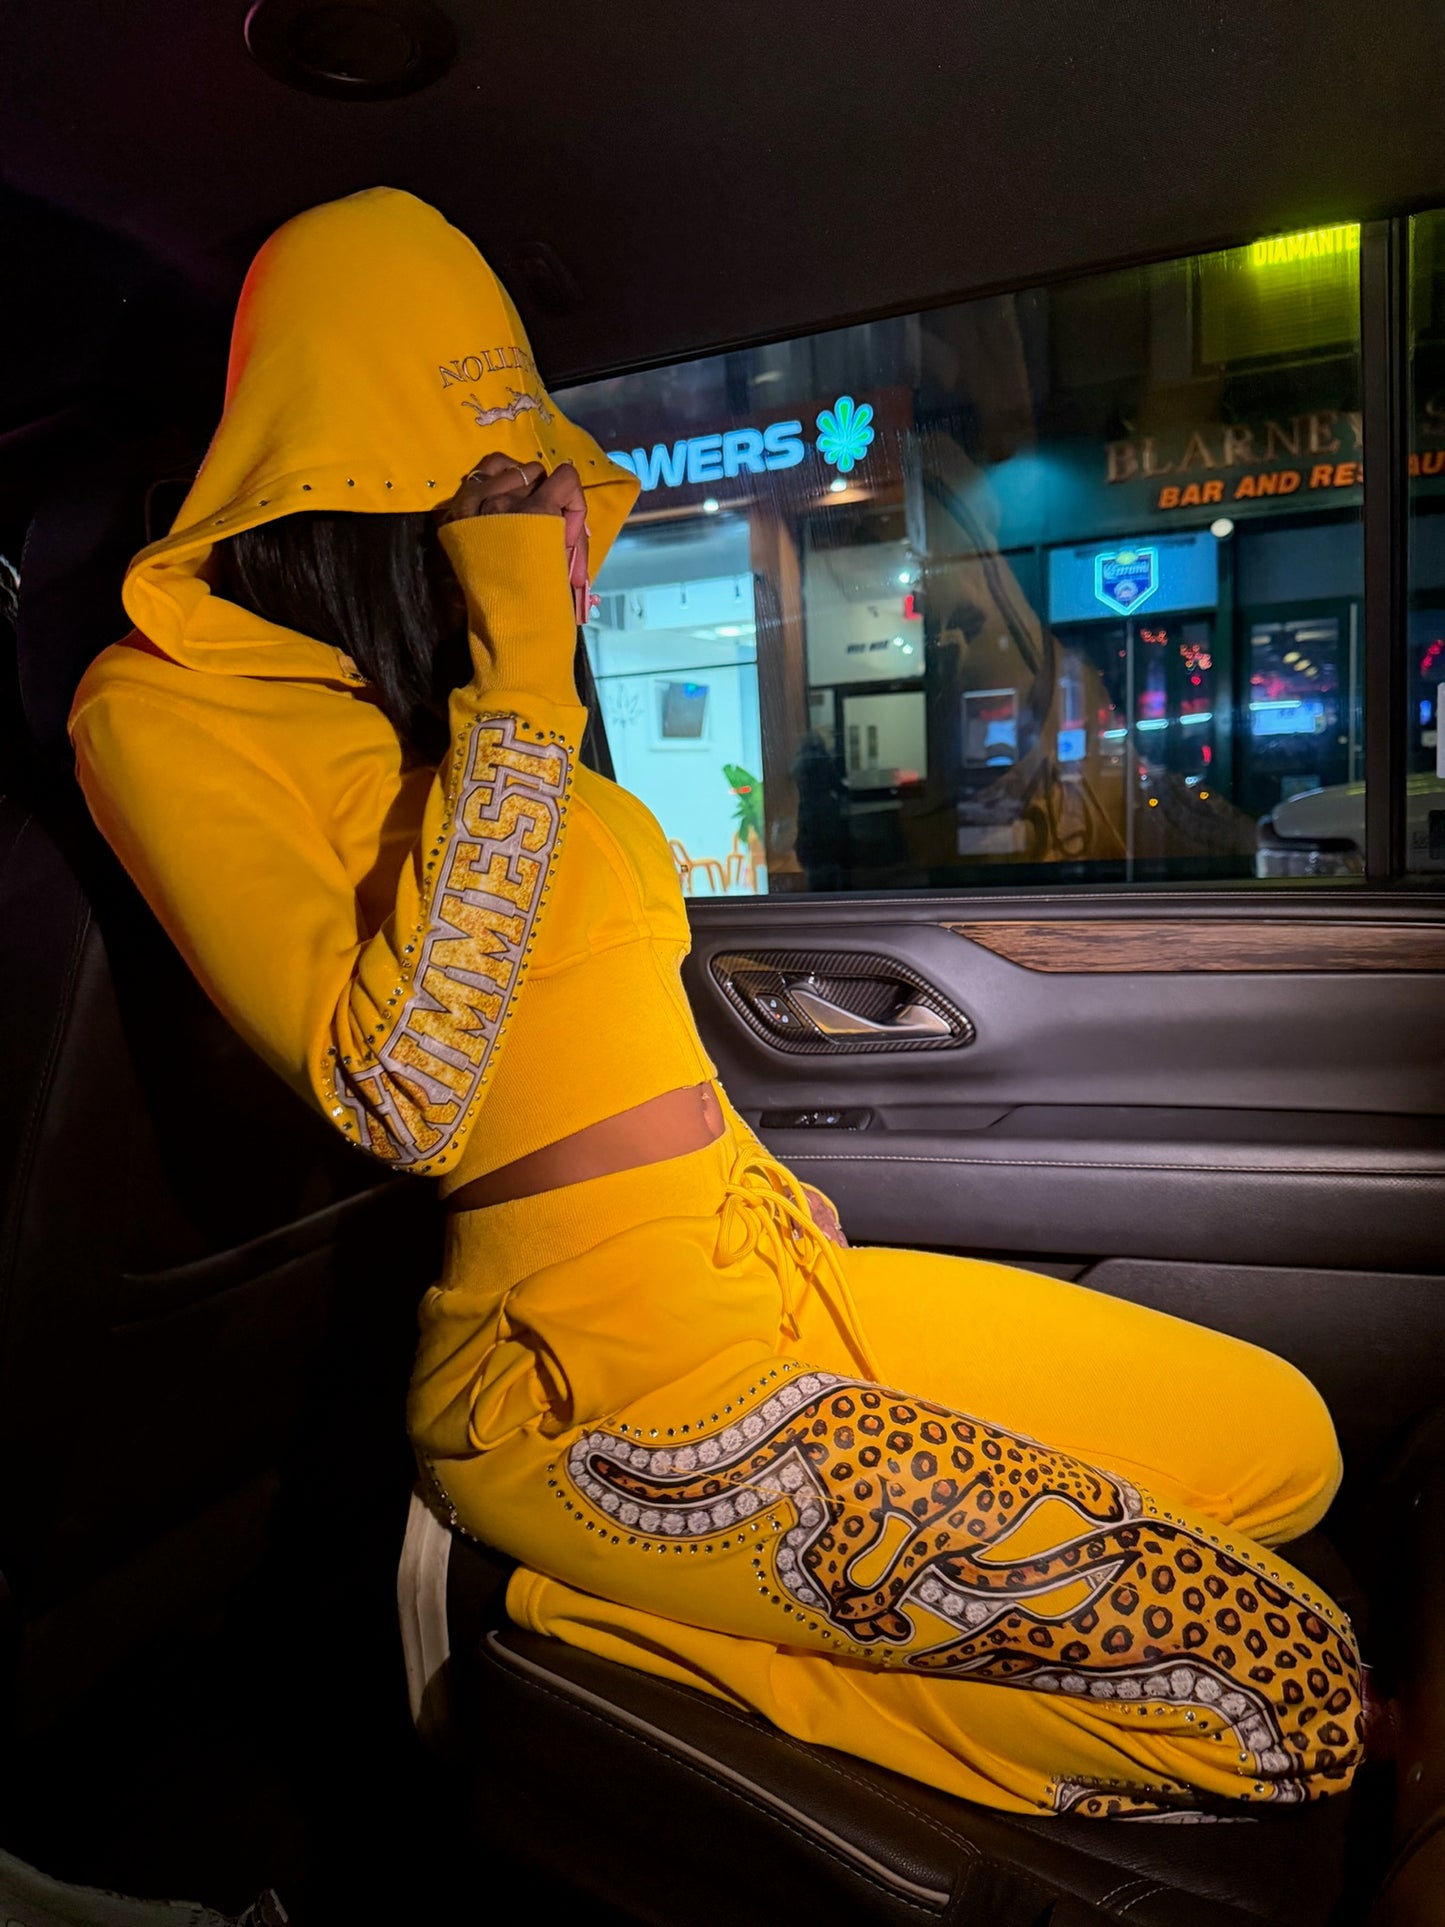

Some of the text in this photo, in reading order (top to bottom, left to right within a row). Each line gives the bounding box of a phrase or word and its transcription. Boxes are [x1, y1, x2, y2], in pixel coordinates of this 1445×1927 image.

[1106, 409, 1363, 483] BLARNEY
[1158, 481, 1224, 510] BAR
[1234, 471, 1300, 499] AND
